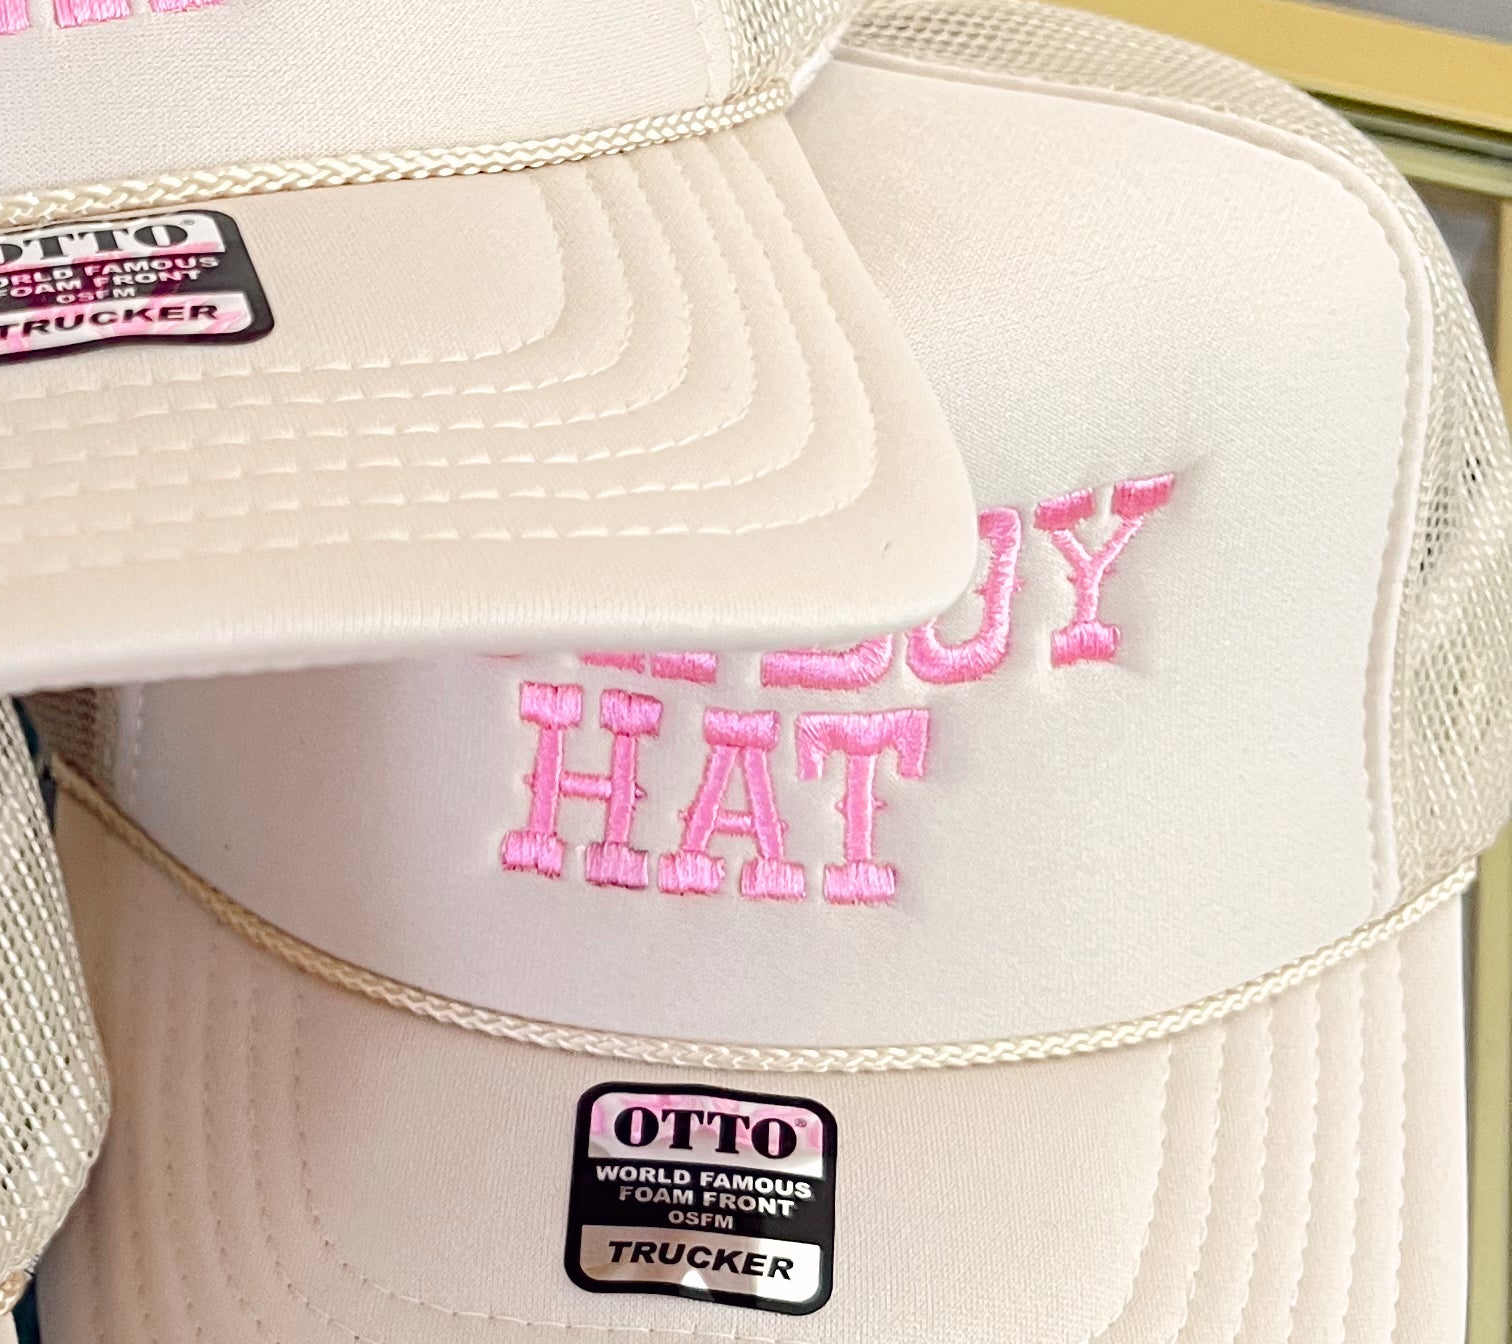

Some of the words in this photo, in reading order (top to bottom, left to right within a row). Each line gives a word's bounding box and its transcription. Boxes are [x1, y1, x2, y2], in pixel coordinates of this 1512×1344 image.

[84, 256, 221, 278] FAMOUS
[93, 268, 202, 289] FRONT
[56, 287, 136, 305] OSFM
[501, 681, 932, 905] HAT
[595, 1165, 691, 1187] WORLD
[699, 1171, 812, 1199] FAMOUS
[618, 1185, 694, 1206] FOAM
[702, 1191, 795, 1217] FRONT
[668, 1210, 735, 1230] OSFM
[608, 1241, 795, 1280] TRUCKER
